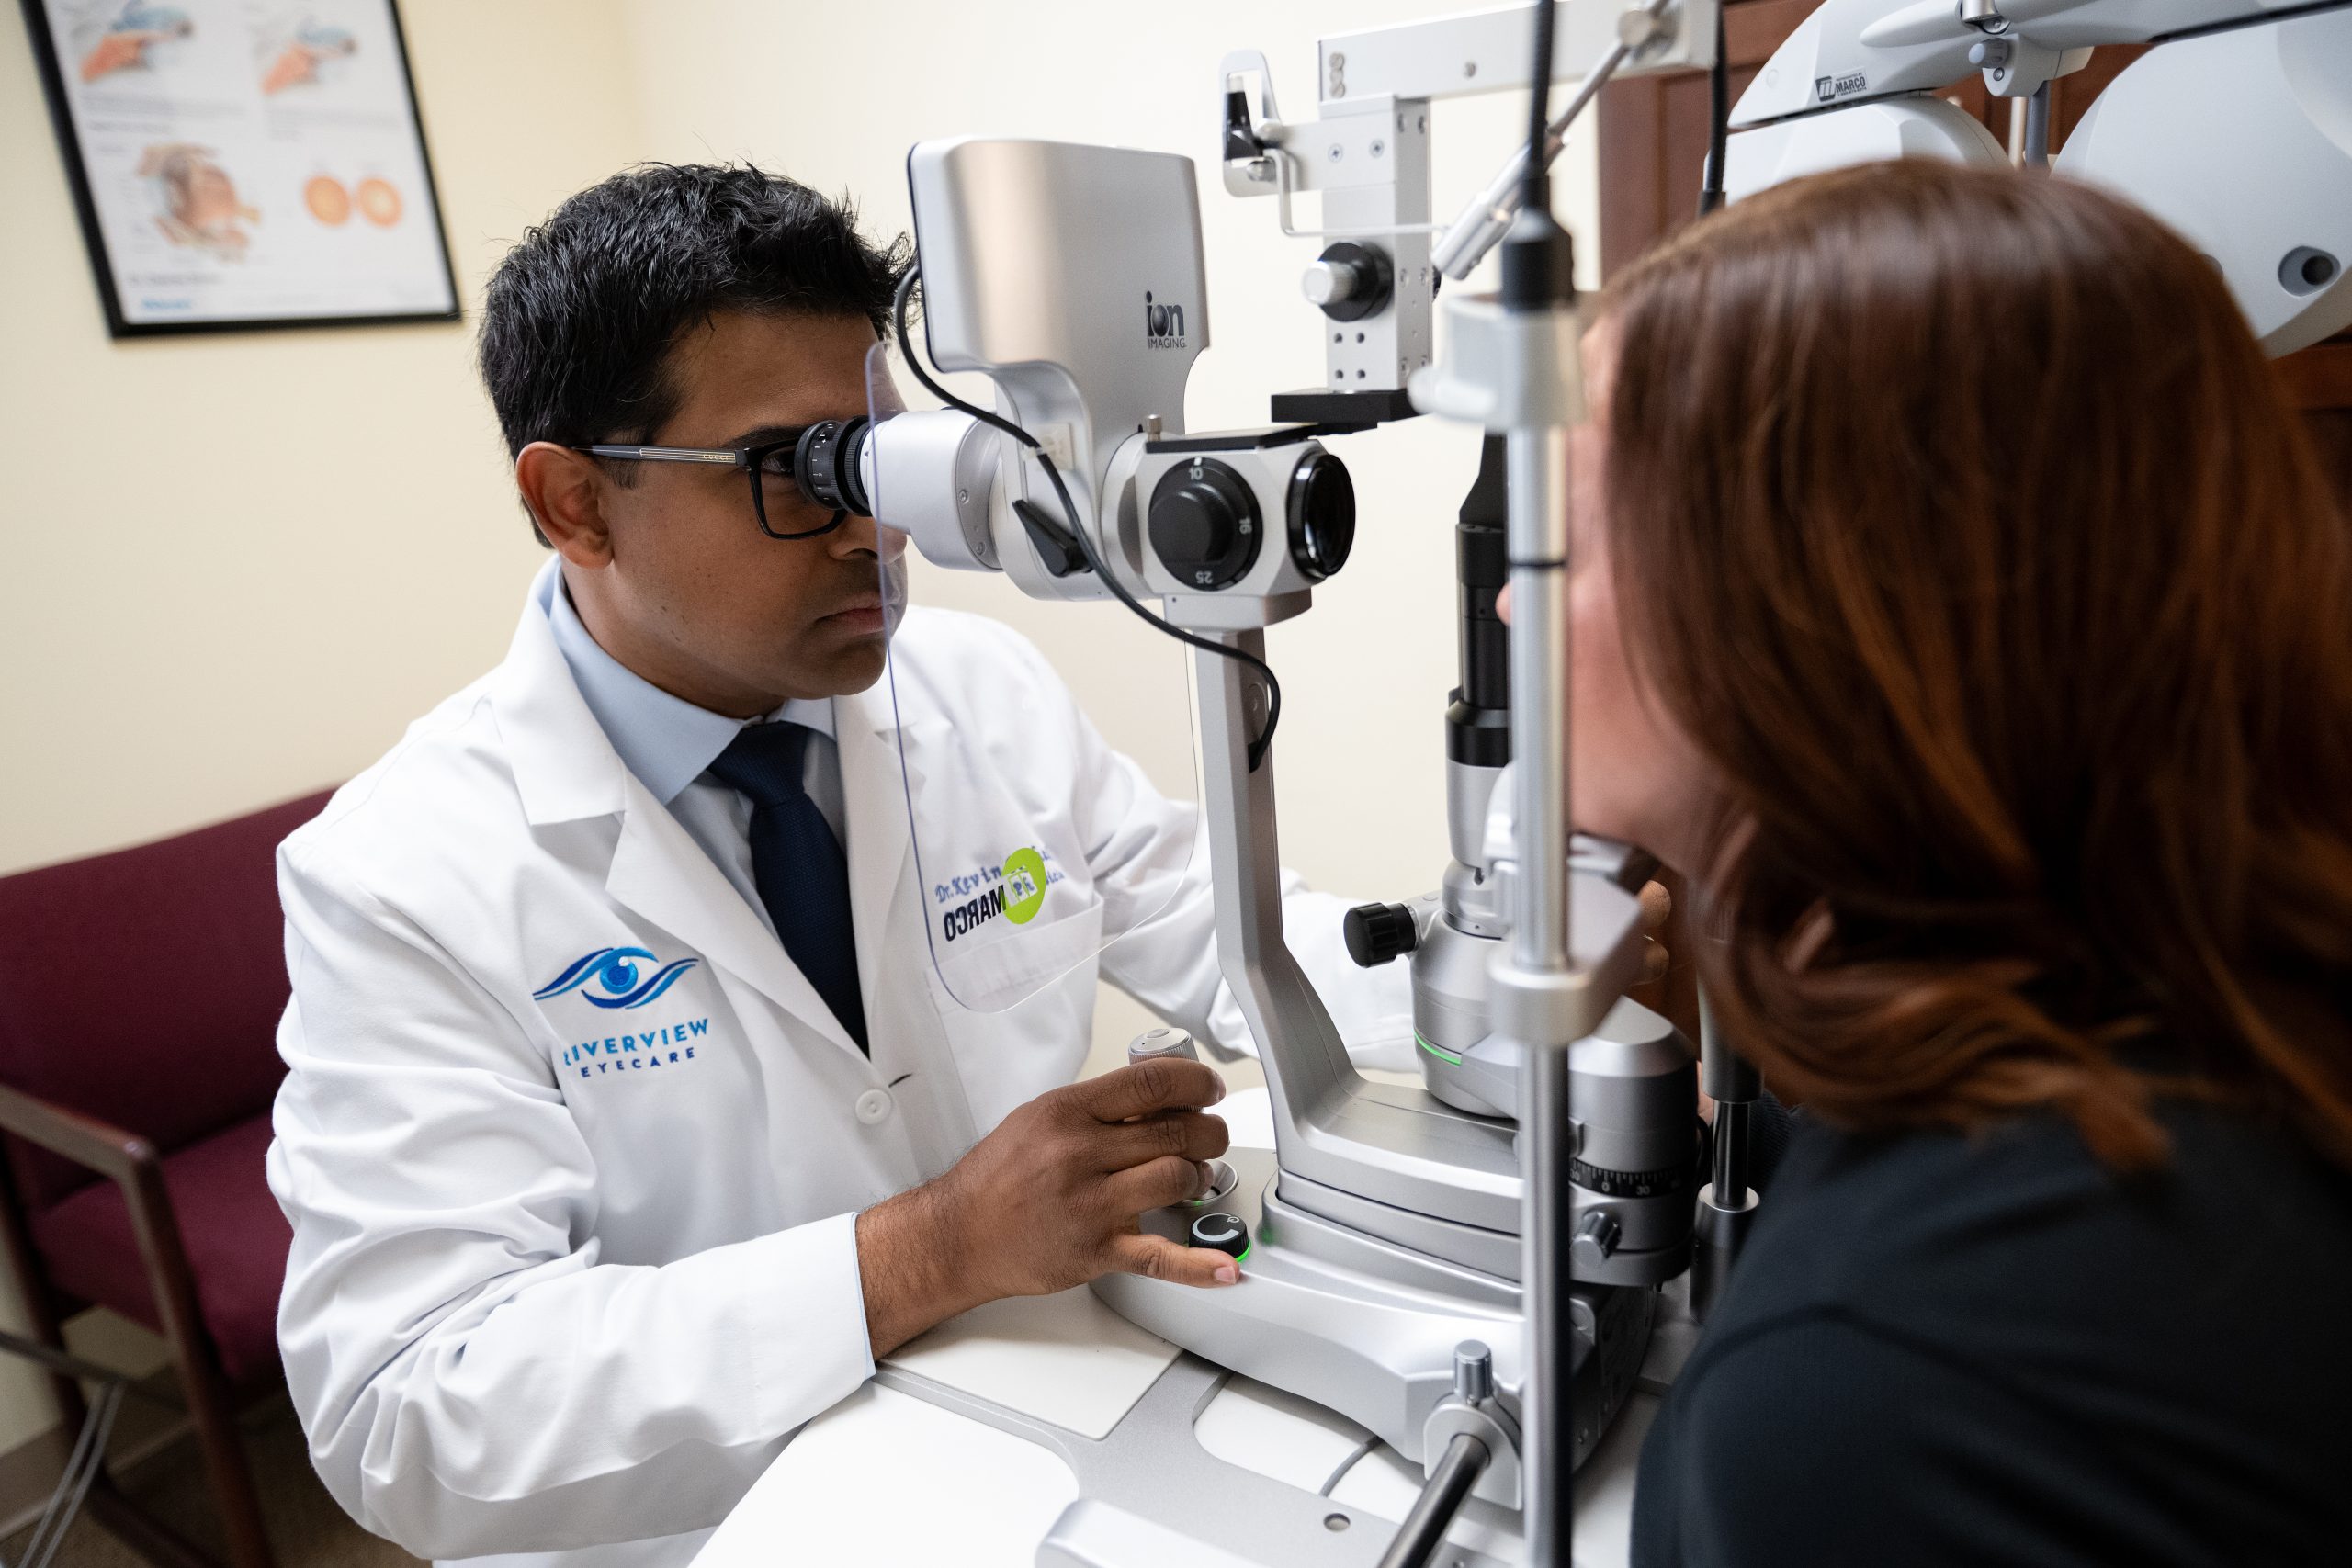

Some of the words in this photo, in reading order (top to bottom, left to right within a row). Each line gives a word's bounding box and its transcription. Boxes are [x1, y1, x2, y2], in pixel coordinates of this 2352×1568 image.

[1835, 76, 1866, 93] MARCO
[1146, 290, 1185, 337] ion
[1148, 337, 1187, 349] IMAGING
[1189, 467, 1204, 480] 10
[1238, 516, 1253, 535] 16
[1195, 570, 1214, 584] 25
[581, 1047, 695, 1078] EYECARE
[1601, 1181, 1610, 1192] 0
[1636, 1185, 1651, 1196] 30
